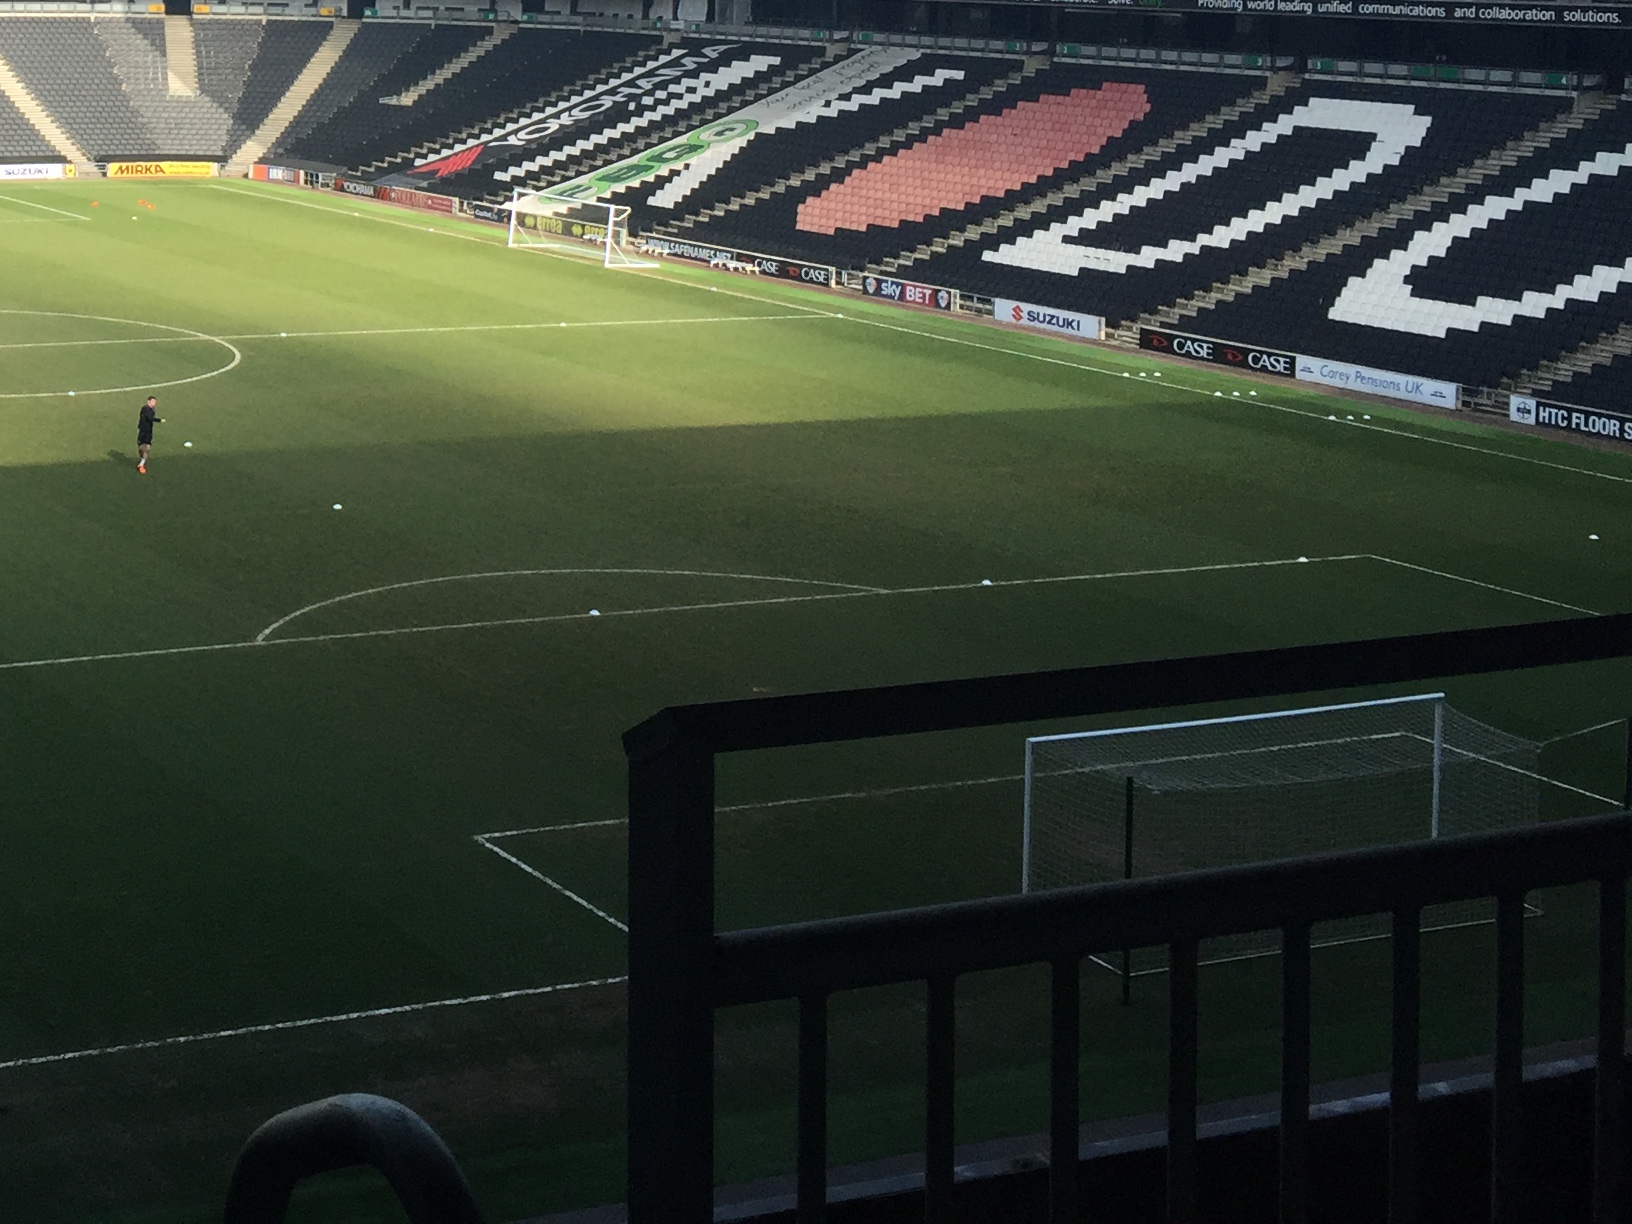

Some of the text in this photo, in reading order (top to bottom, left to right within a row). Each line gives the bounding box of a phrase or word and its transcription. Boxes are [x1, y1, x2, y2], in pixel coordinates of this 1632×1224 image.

[1277, 0, 1312, 14] leading
[1318, 0, 1352, 13] unified
[1358, 2, 1446, 18] communications
[1454, 5, 1476, 18] and
[1479, 6, 1555, 21] collaboration
[1563, 8, 1622, 24] solutions.
[487, 42, 742, 147] YOKOHAMA
[4, 167, 49, 176] SUZUKI
[114, 164, 166, 176] MIRKA
[537, 216, 563, 234] errea
[754, 258, 780, 275] CASE
[801, 267, 828, 284] CASE
[880, 279, 933, 304] sky BET
[1026, 310, 1081, 332] SUZUKI
[1173, 337, 1214, 360] CASE
[1248, 352, 1291, 374] CASE
[1354, 370, 1401, 391] Pensions
[1405, 380, 1424, 396] UK
[1539, 406, 1568, 427] HTC
[1571, 411, 1621, 438] FLOOR
